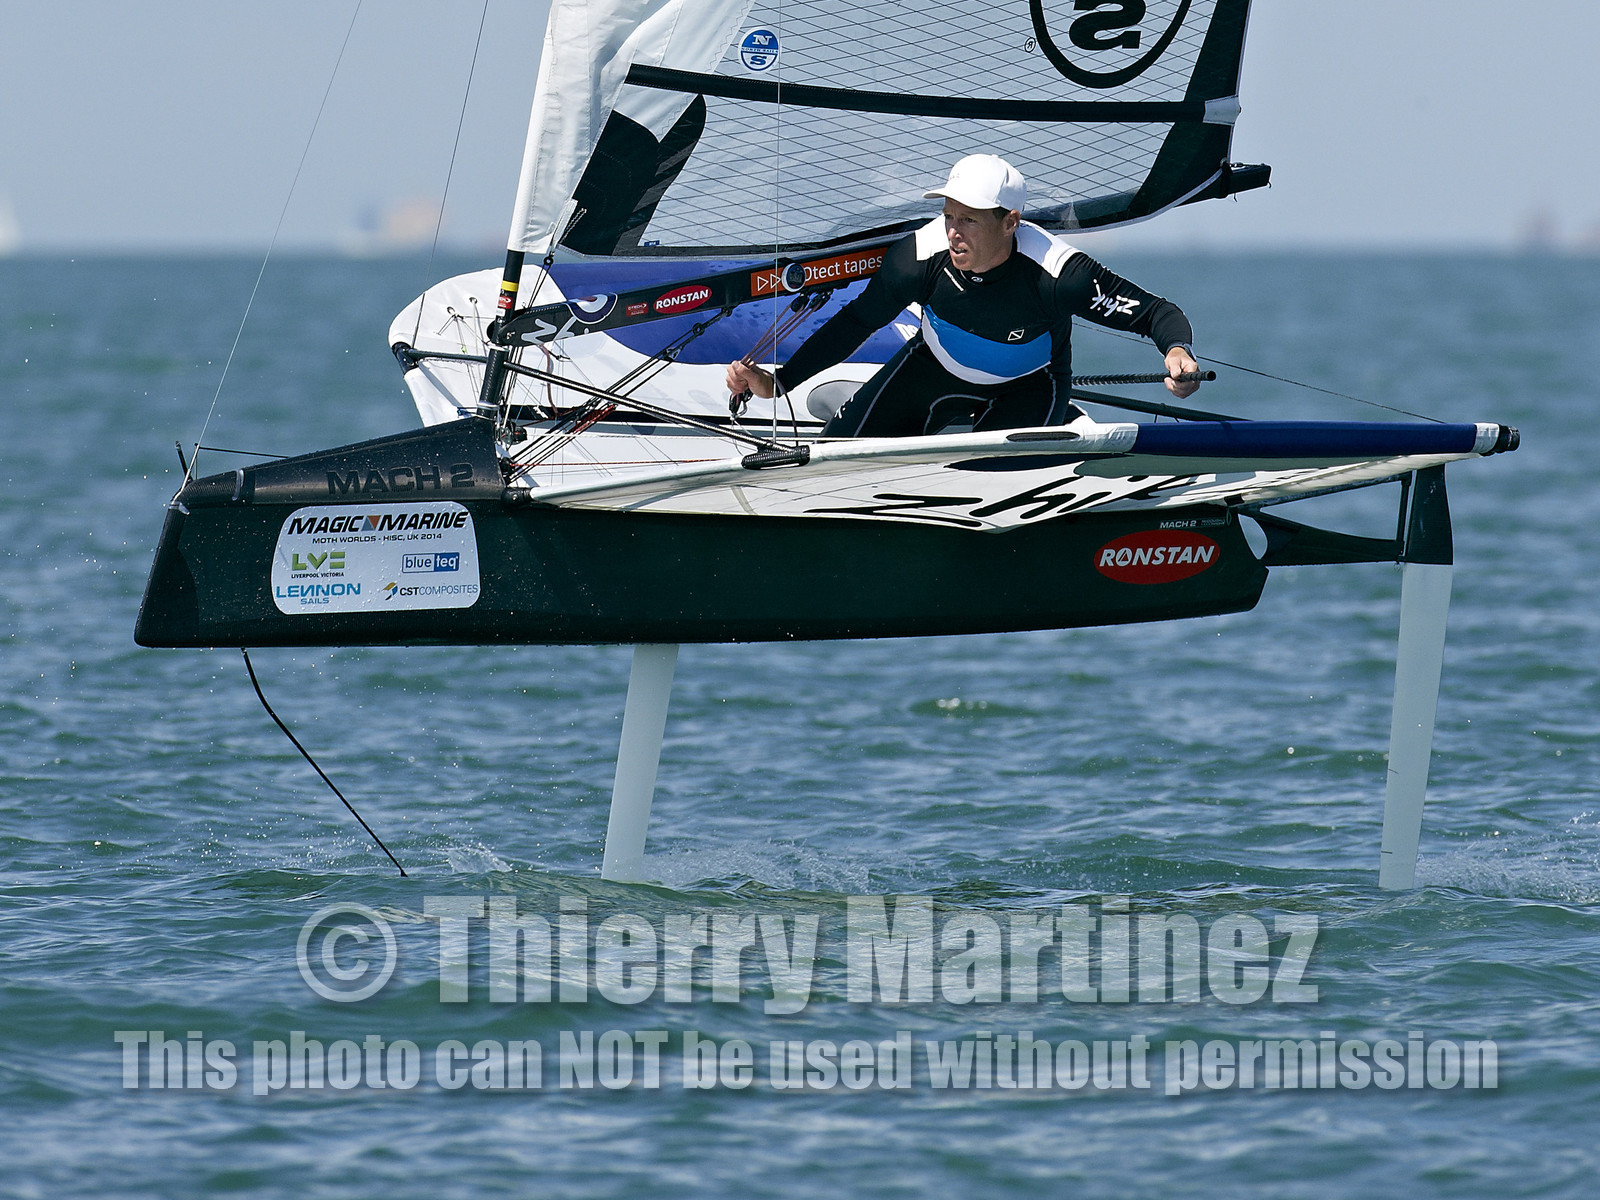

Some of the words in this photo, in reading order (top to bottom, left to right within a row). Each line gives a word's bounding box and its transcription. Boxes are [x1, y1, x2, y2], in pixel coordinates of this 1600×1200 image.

[843, 255, 883, 275] tapes
[656, 289, 709, 310] RONSTAN
[326, 464, 441, 495] MACH
[451, 462, 475, 488] 2
[288, 515, 364, 535] MAGIC
[378, 512, 468, 531] MARINE
[1160, 521, 1188, 529] MACH
[383, 534, 405, 542] HISC,
[1100, 545, 1215, 567] RONSTAN
[300, 597, 330, 605] SAILS
